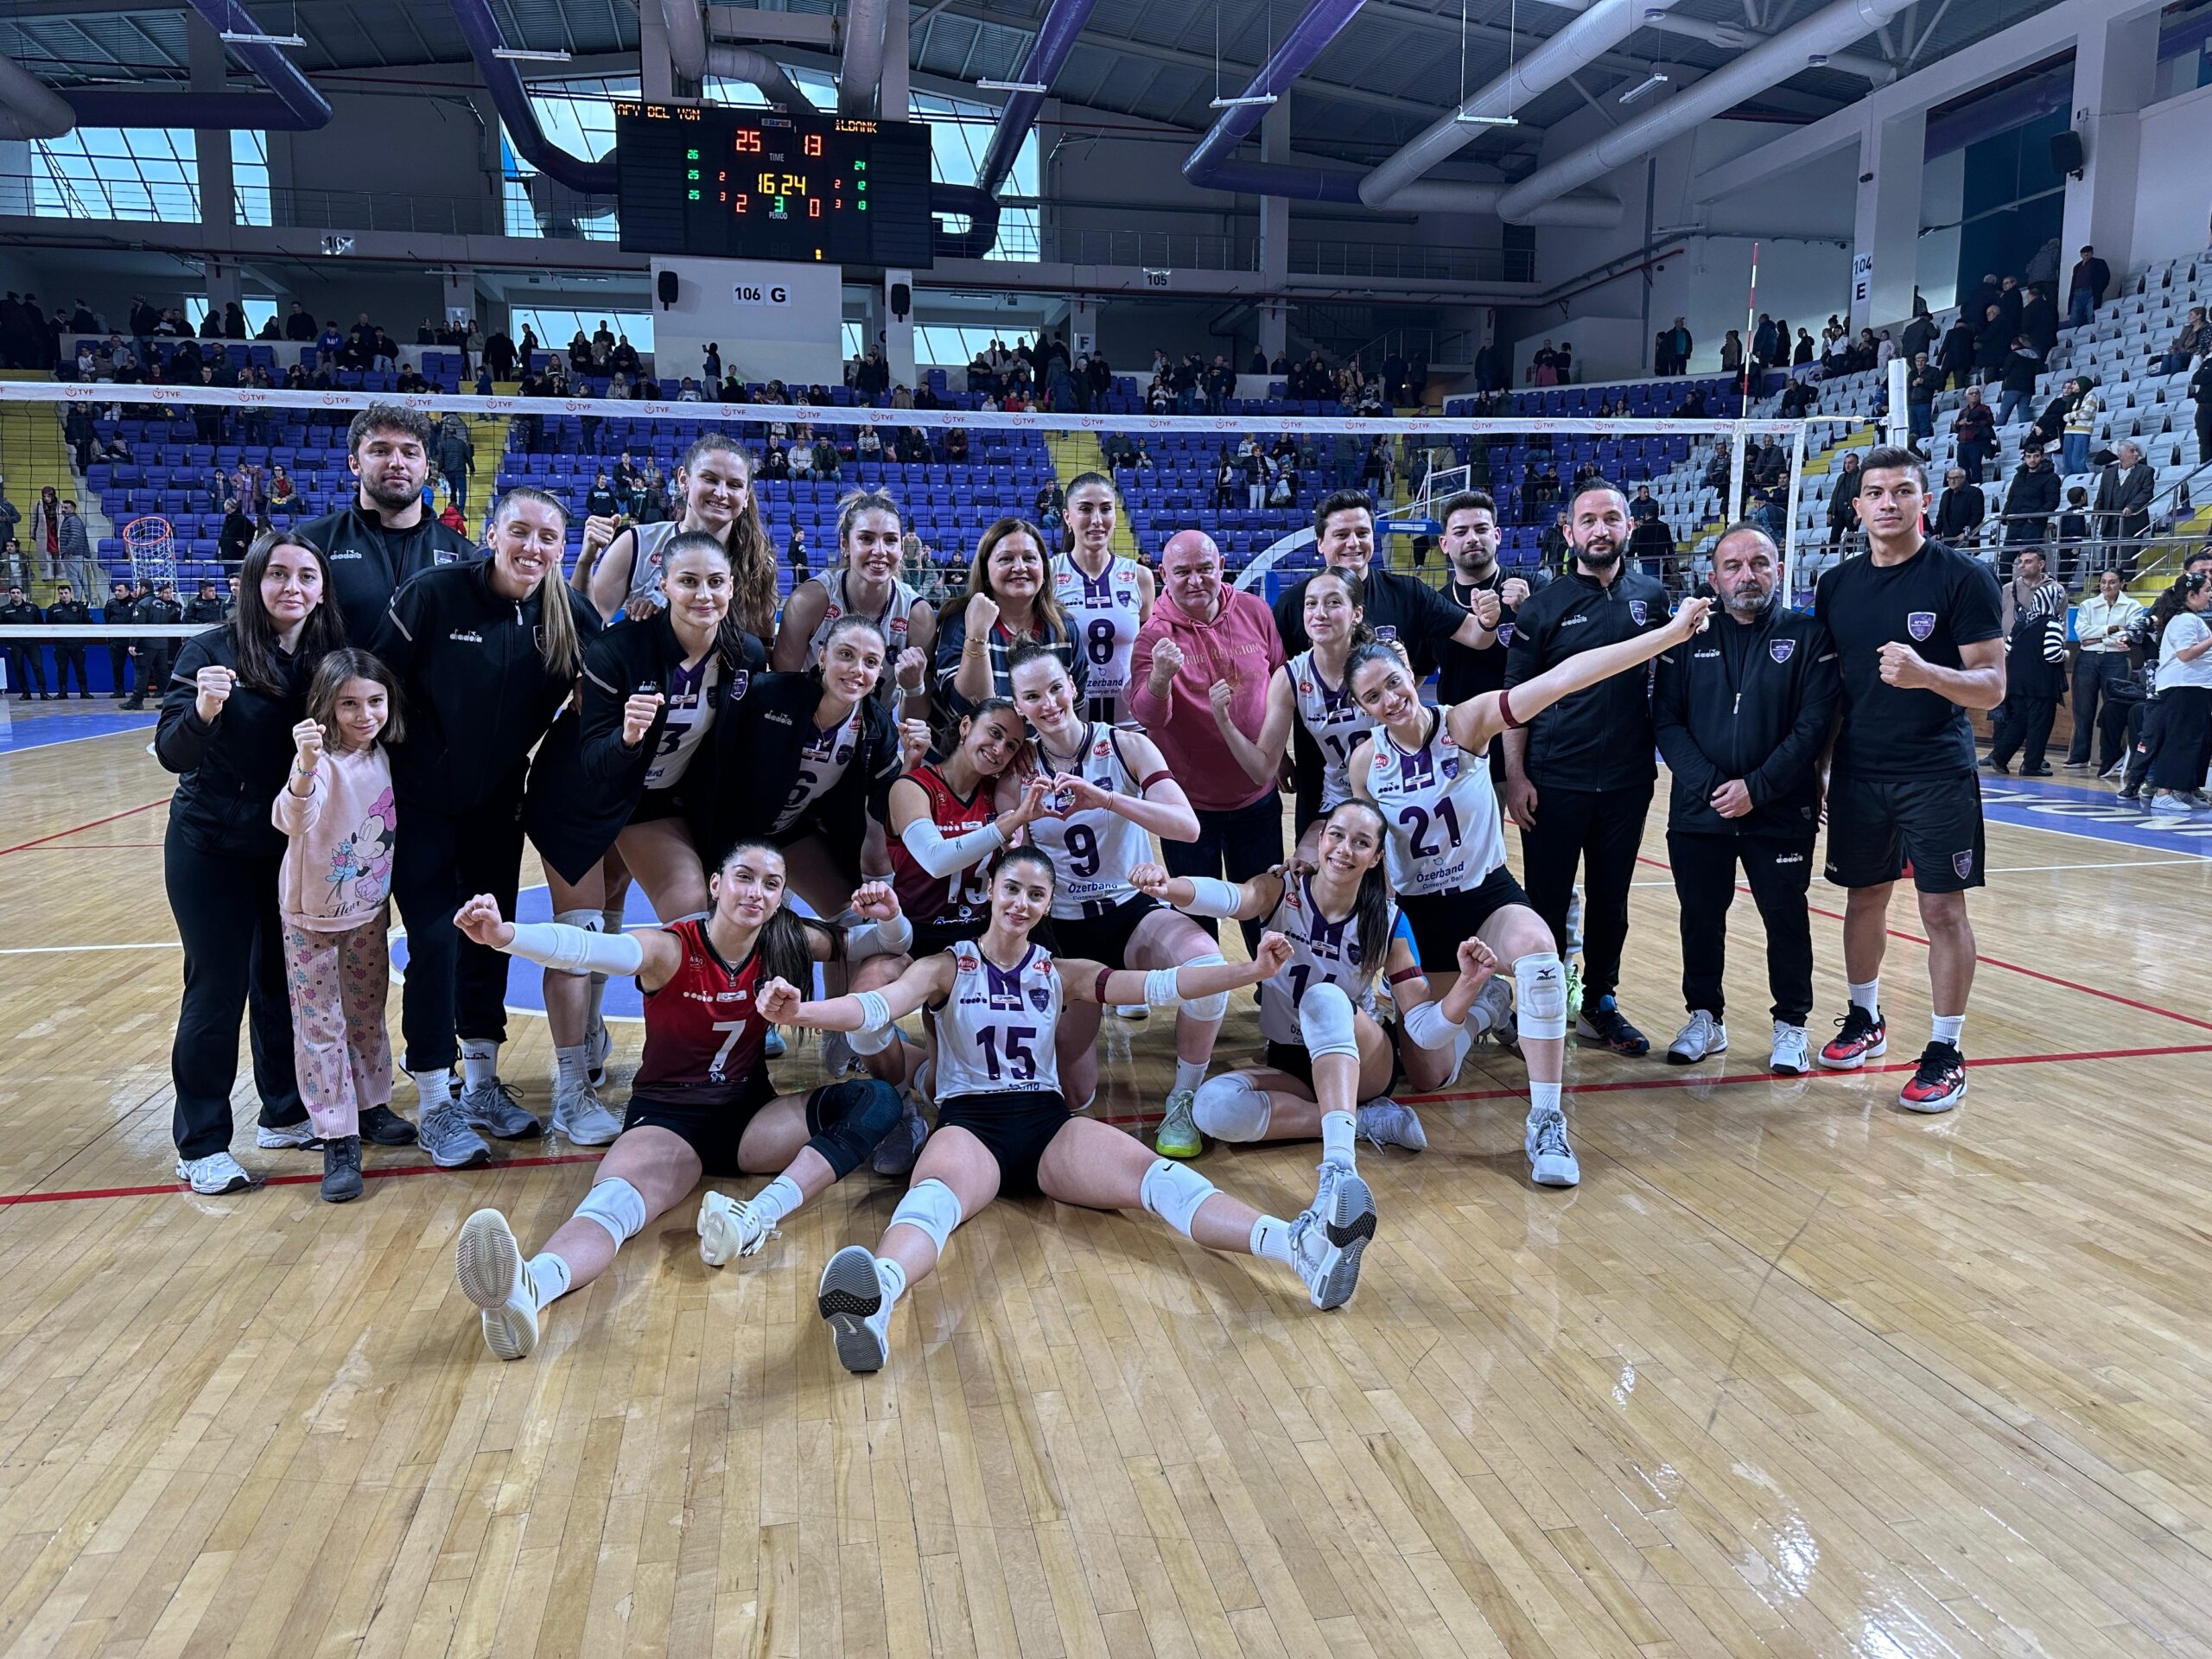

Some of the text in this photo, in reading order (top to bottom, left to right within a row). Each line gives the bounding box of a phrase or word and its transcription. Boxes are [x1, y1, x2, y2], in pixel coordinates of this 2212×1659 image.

[736, 130, 760, 152] 25
[804, 135, 822, 156] 13
[688, 149, 698, 160] 26
[769, 153, 785, 162] TIME
[855, 161, 866, 170] 24
[688, 169, 699, 180] 25
[719, 171, 726, 181] 2
[758, 173, 806, 196] 16 24
[835, 179, 841, 188] 2
[858, 181, 866, 190] 12
[689, 189, 700, 200] 25
[720, 192, 727, 201] 3
[736, 194, 747, 213] 2
[774, 195, 784, 213] 3
[810, 198, 820, 217] 0
[835, 199, 842, 208] 3
[858, 200, 867, 210] 13
[769, 211, 788, 219] PERIOD
[1854, 256, 1872, 275] 104
[1147, 274, 1167, 286] 105
[734, 287, 761, 301] 106
[771, 287, 786, 303] G
[1856, 283, 1866, 301] E
[1080, 336, 1090, 349] F
[1087, 618, 1116, 665] 8
[1185, 654, 1207, 665] RUE
[1087, 677, 1124, 687] zerband
[1398, 796, 1462, 860] 21
[1064, 823, 1101, 878] 9
[1416, 861, 1464, 882] Özerband
[1288, 963, 1338, 1009] 1
[709, 1019, 747, 1073] 7
[976, 1025, 1038, 1081] 15
